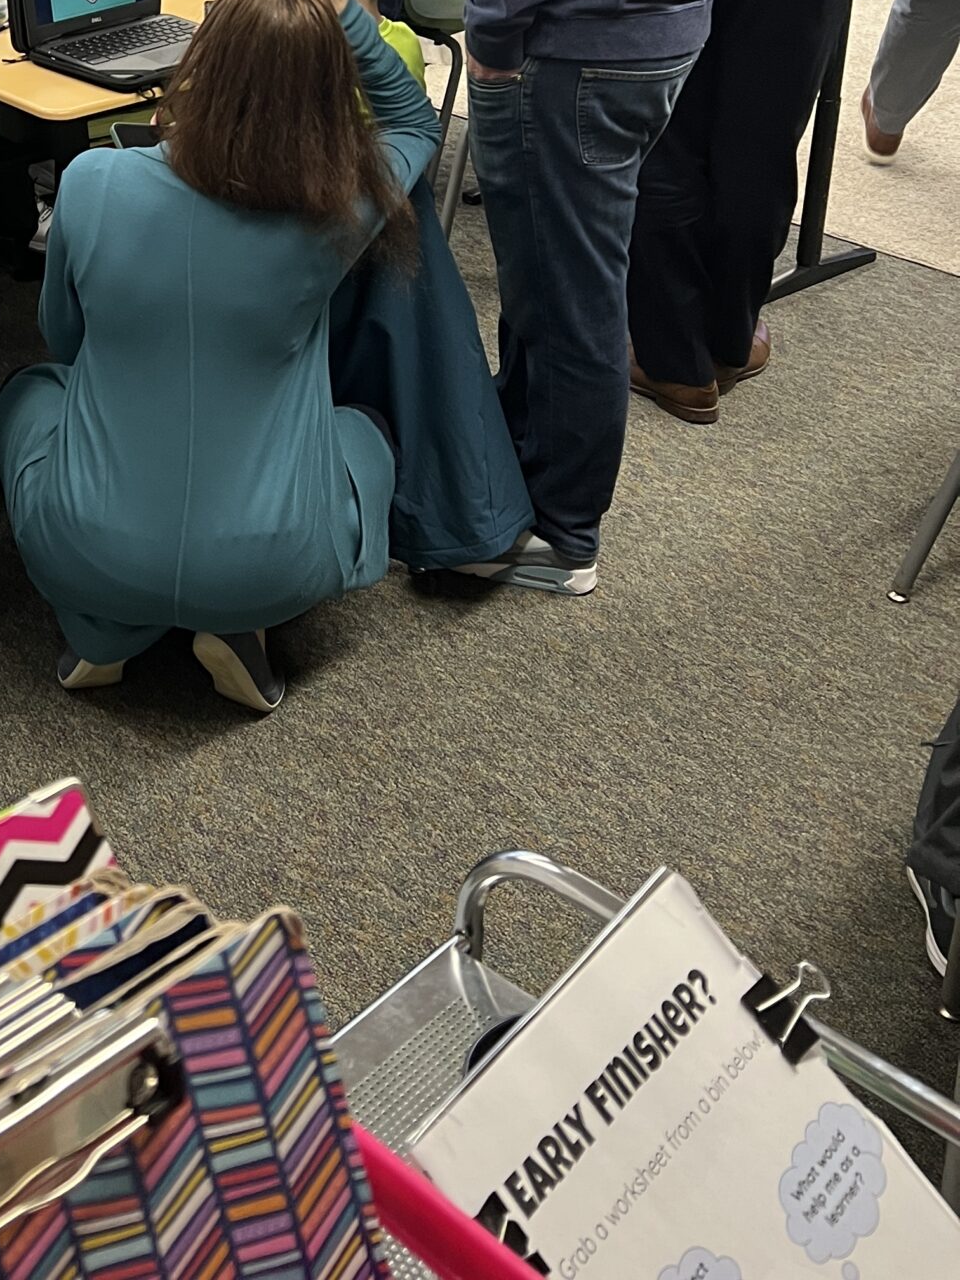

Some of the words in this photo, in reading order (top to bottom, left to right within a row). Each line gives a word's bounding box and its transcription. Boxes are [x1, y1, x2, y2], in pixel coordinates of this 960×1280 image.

[504, 1102, 596, 1220] EARLY
[558, 1236, 598, 1280] Grab
[595, 1222, 610, 1241] a
[604, 1144, 674, 1227] worksheet
[664, 1110, 703, 1152] from
[698, 1096, 712, 1115] a
[705, 1066, 732, 1103] bin
[790, 1165, 820, 1202] What
[818, 1128, 846, 1169] would
[803, 1193, 828, 1224] help
[824, 1171, 842, 1198] me
[840, 1154, 855, 1176] as
[851, 1145, 861, 1158] a
[824, 1171, 866, 1228] learner?
